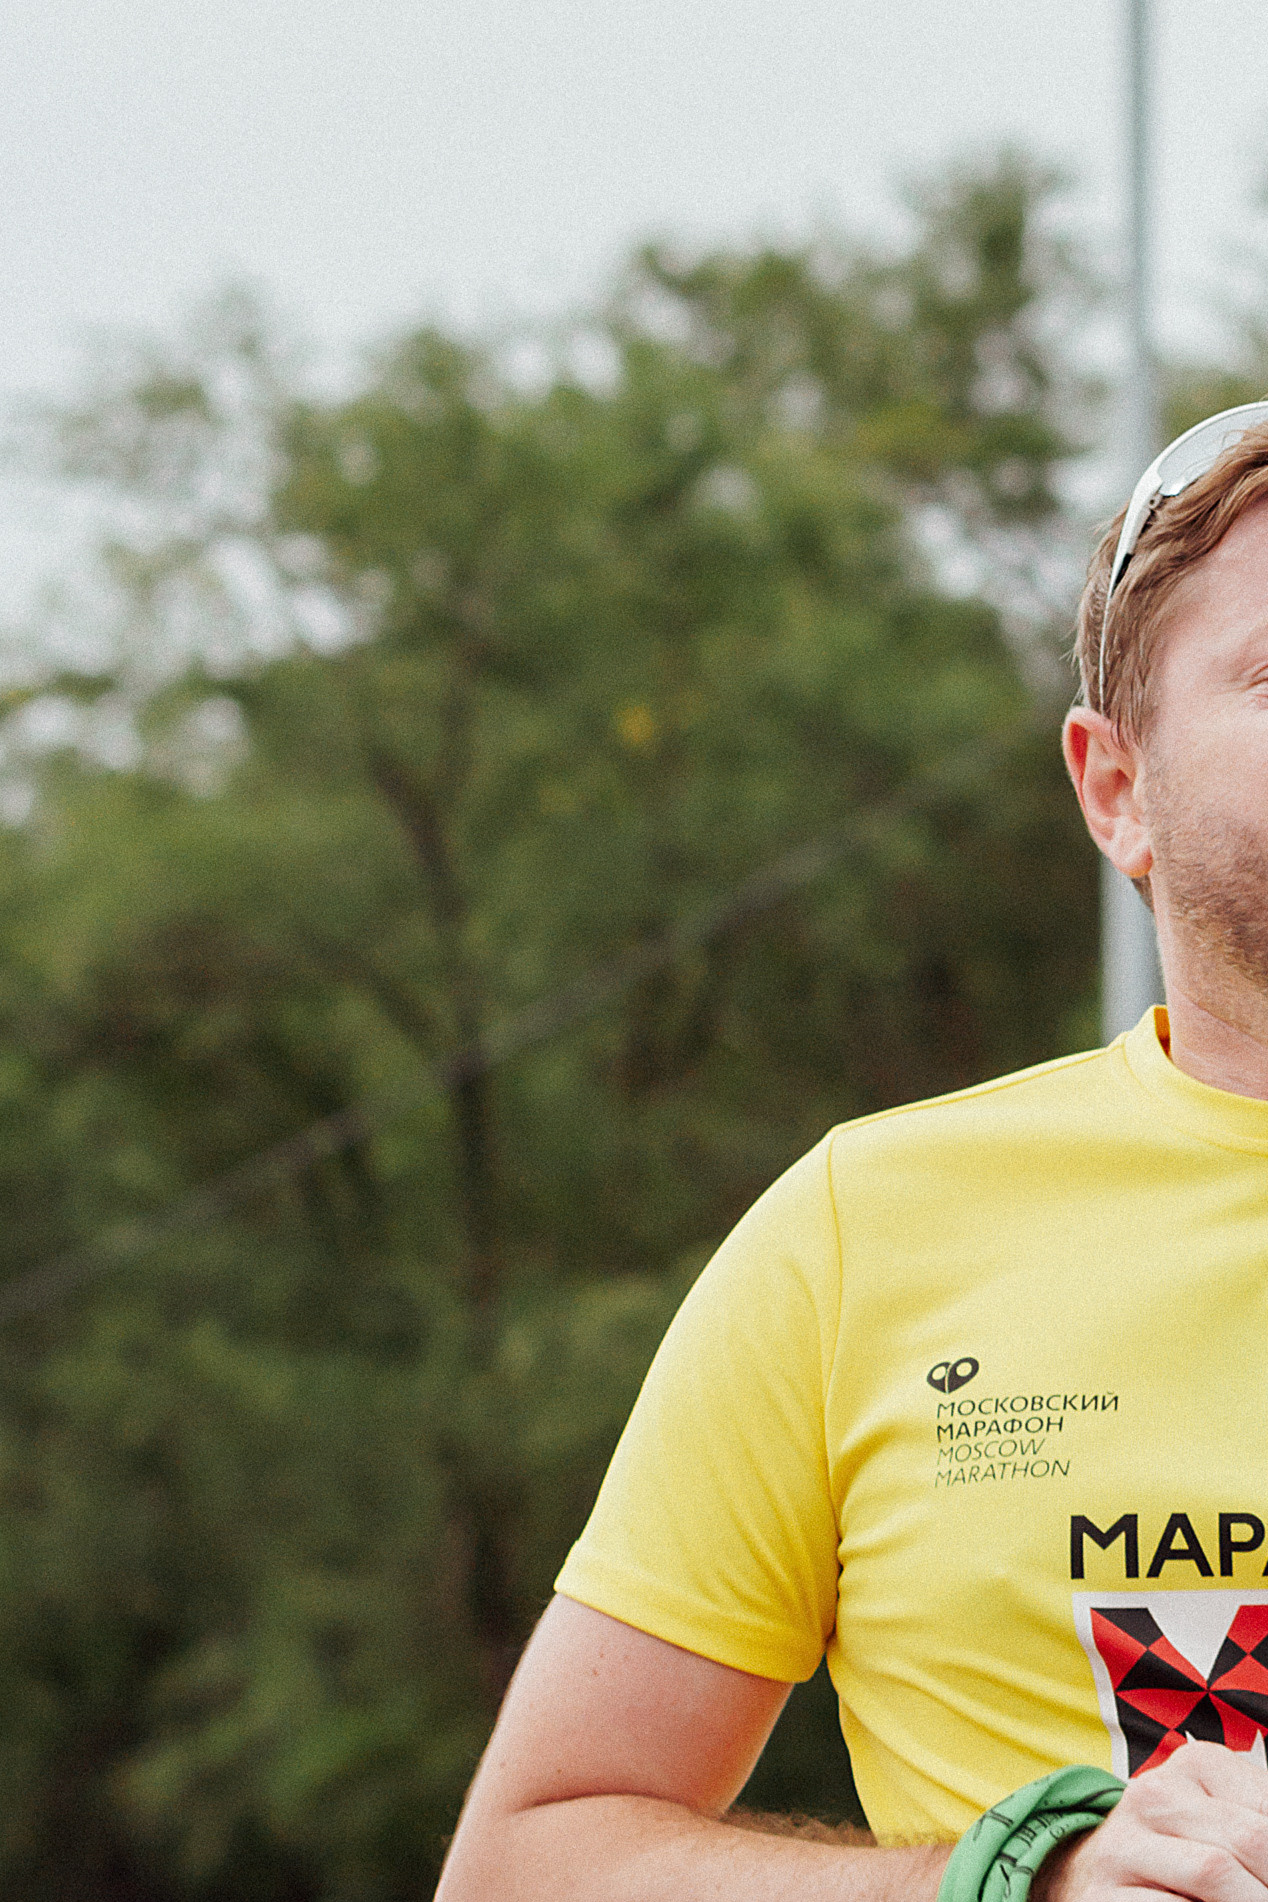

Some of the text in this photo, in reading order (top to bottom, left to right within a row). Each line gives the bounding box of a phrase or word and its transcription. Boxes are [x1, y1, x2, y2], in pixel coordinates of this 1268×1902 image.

[937, 1392, 1119, 1419] МОСКОВСКИЙ
[937, 1416, 1064, 1443] МАРАФОН
[937, 1438, 1046, 1466] MOSCOW
[935, 1460, 1071, 1488] MARATHON
